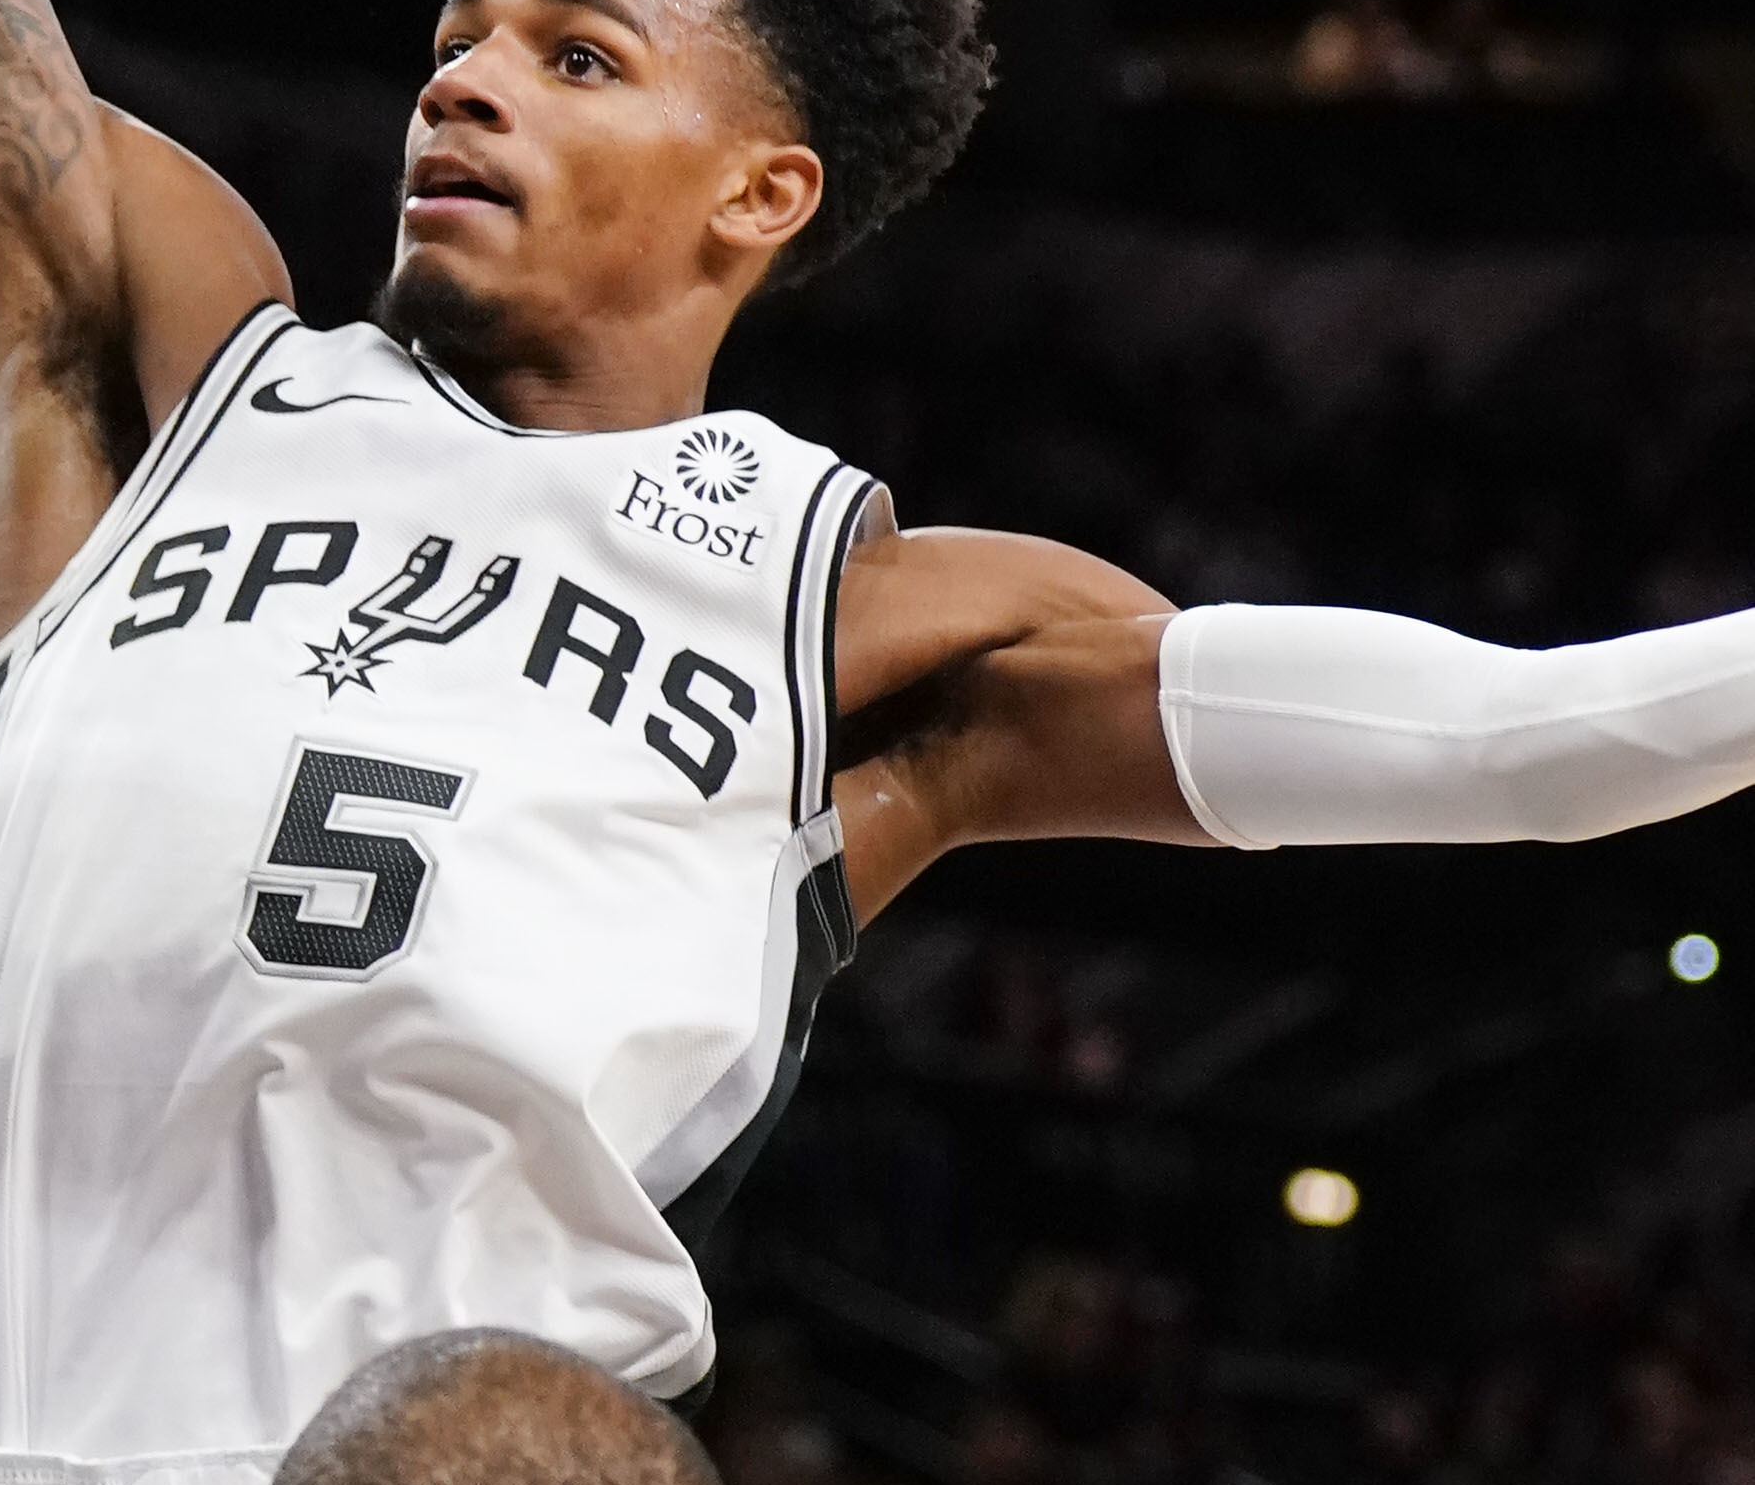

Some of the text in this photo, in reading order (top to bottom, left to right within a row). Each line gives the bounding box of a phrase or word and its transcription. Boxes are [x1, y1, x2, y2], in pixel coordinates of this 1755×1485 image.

[616, 469, 765, 566] Frost
[110, 520, 757, 801] SPURS
[241, 742, 473, 977] 5
